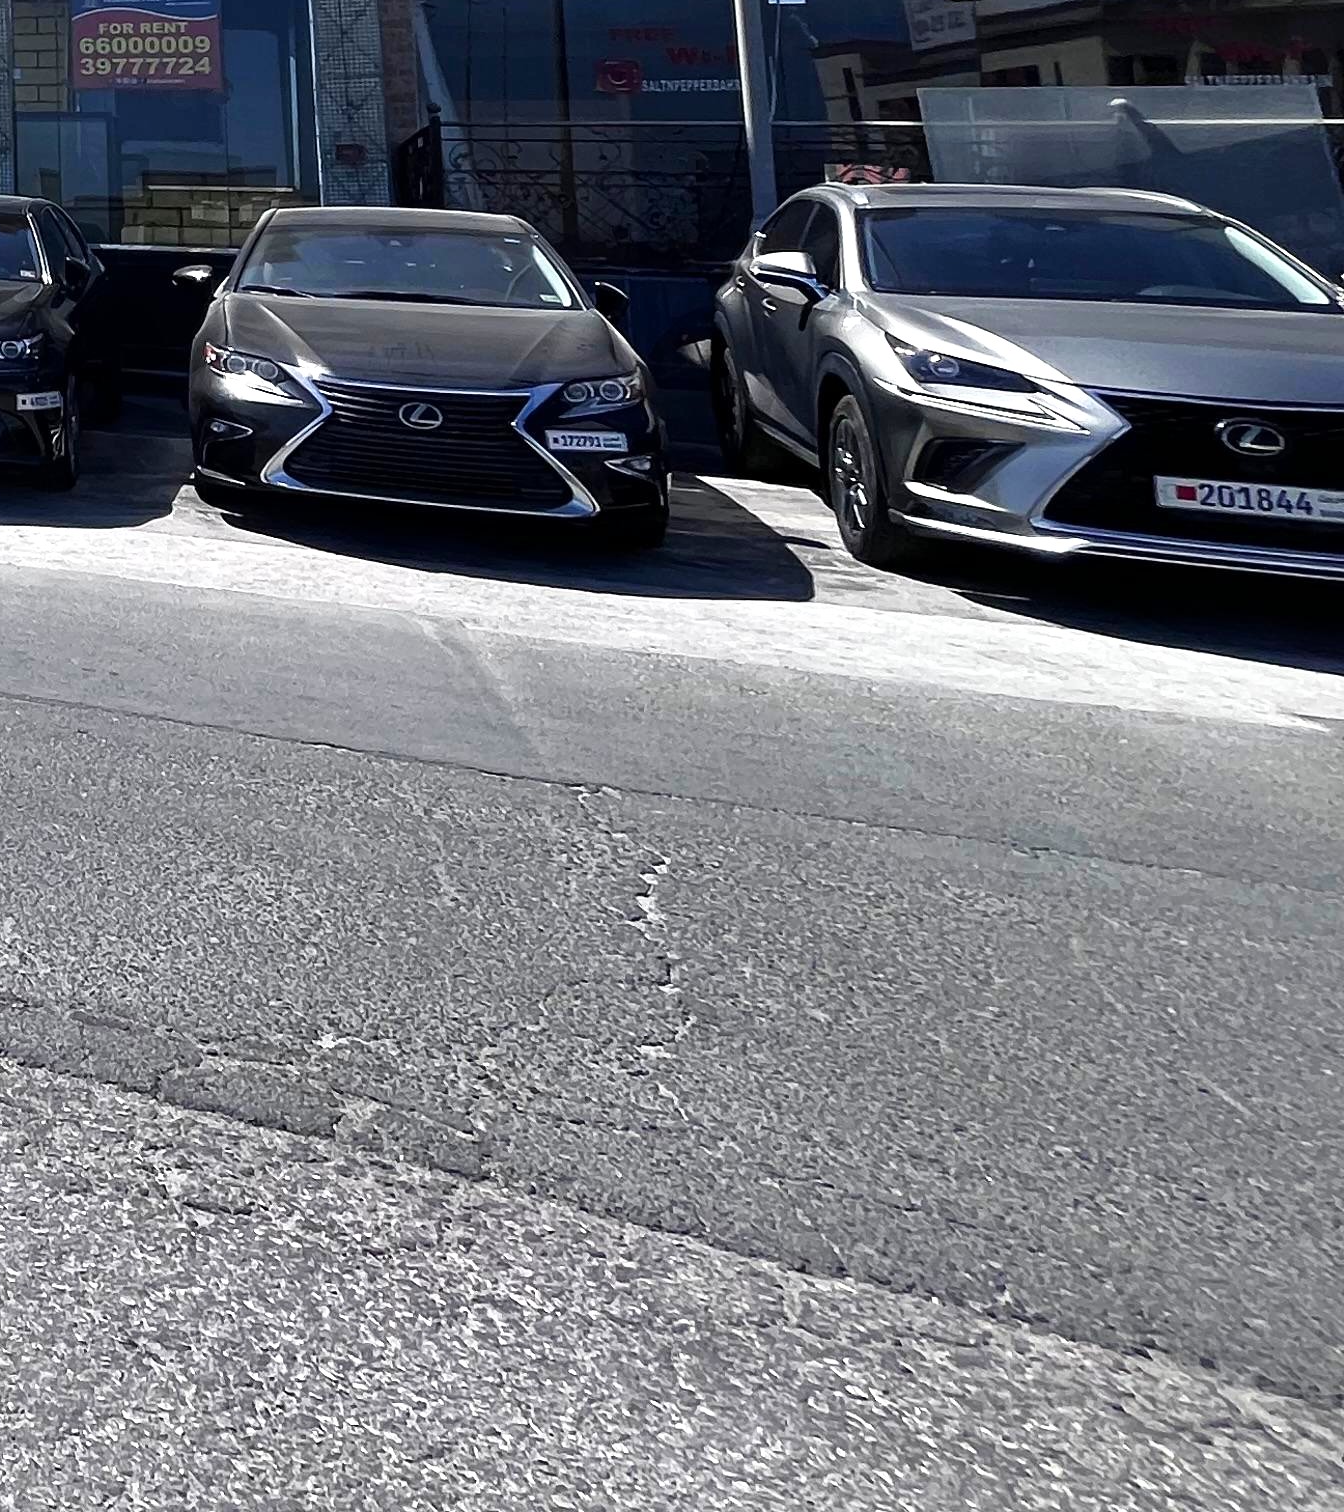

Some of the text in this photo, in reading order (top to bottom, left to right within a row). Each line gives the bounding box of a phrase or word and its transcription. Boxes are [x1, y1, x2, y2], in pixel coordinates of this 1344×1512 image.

[99, 22, 188, 34] FOR RENT
[79, 36, 211, 54] 66000009
[80, 56, 210, 75] 39777724
[1198, 483, 1314, 515] 201844
